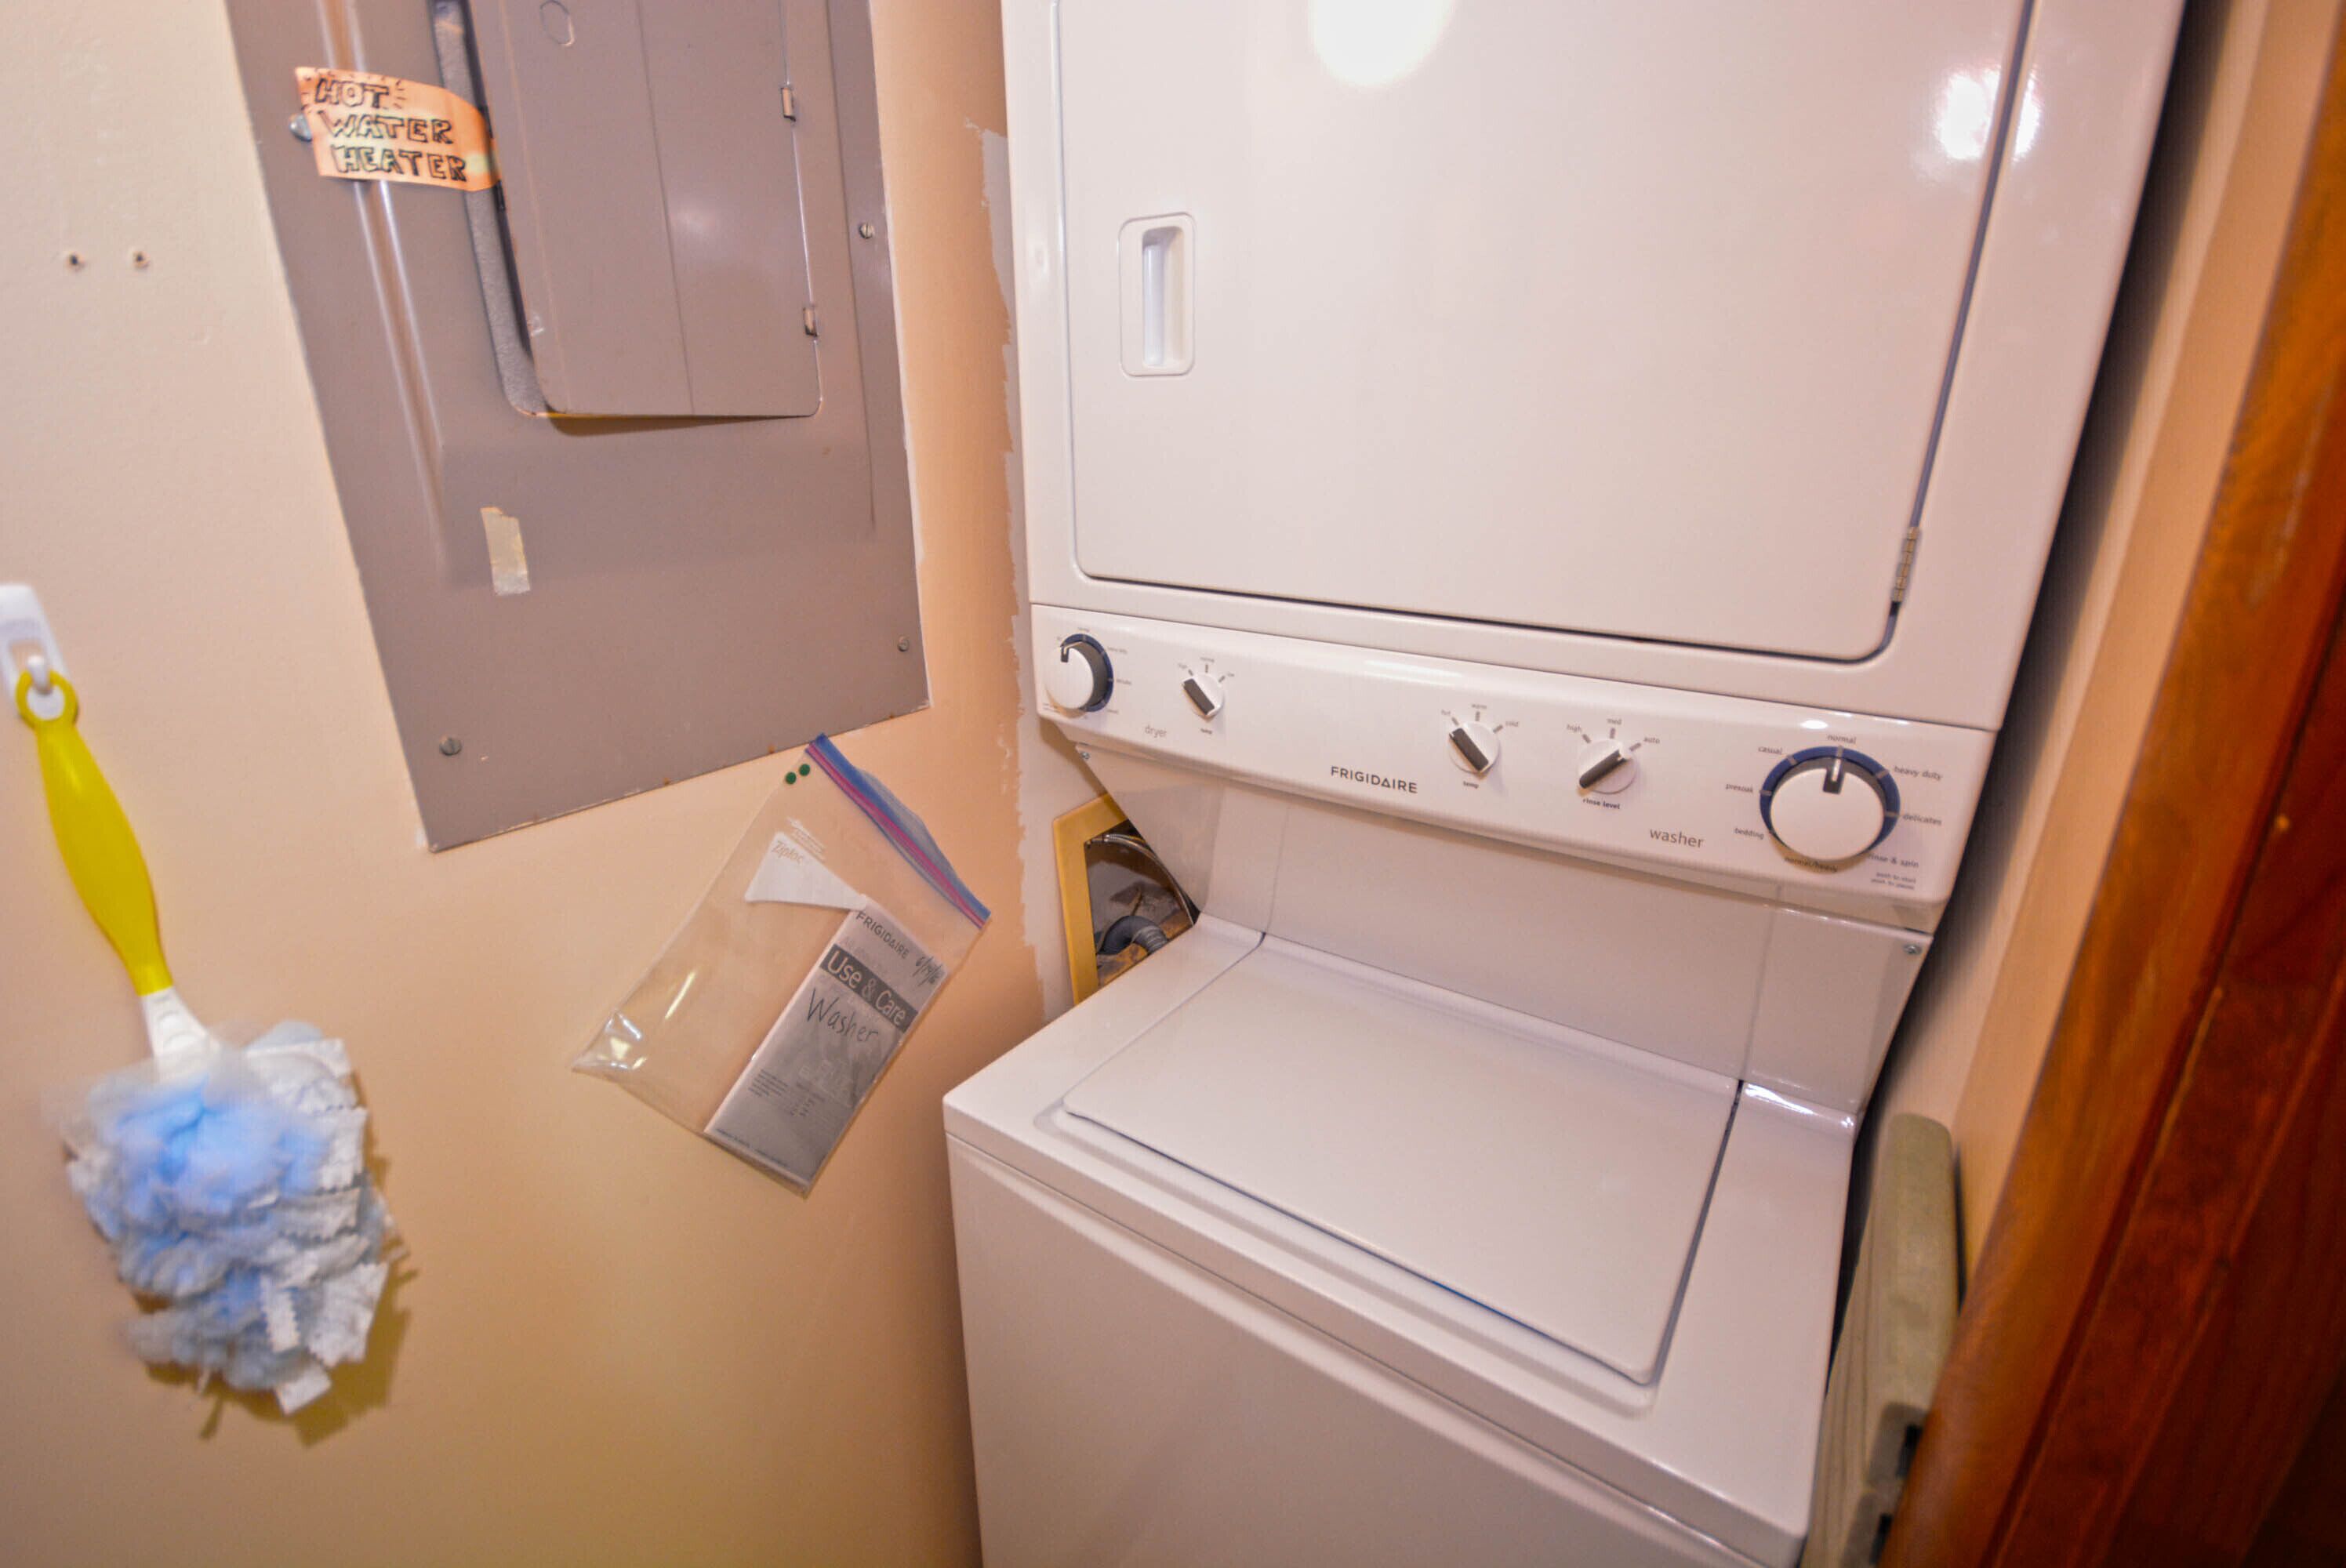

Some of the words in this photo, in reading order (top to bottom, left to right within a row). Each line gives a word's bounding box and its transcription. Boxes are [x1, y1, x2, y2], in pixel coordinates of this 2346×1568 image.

[315, 78, 389, 109] HOT
[317, 110, 453, 144] WATER
[331, 144, 467, 182] HEATER
[1145, 724, 1168, 739] dryer
[1566, 724, 1582, 734] high
[1643, 736, 1660, 745] auto
[1826, 734, 1857, 745] normal
[1758, 746, 1783, 755] casual
[1331, 766, 1418, 794] FRIGIDAIRE
[1894, 765, 1919, 778] heavy
[1922, 770, 1943, 782] duty
[1725, 783, 1753, 793] presoak
[1582, 797, 1600, 807] rinse
[1603, 800, 1621, 810] level
[1902, 813, 1943, 826] delicates
[1650, 829, 1705, 848] washer
[1734, 827, 1765, 840] bedding
[856, 911, 910, 960] FRIGIDAIRE
[827, 950, 862, 989] Use
[863, 978, 877, 1002] &
[875, 989, 907, 1025] Care
[807, 988, 878, 1042] Washer
